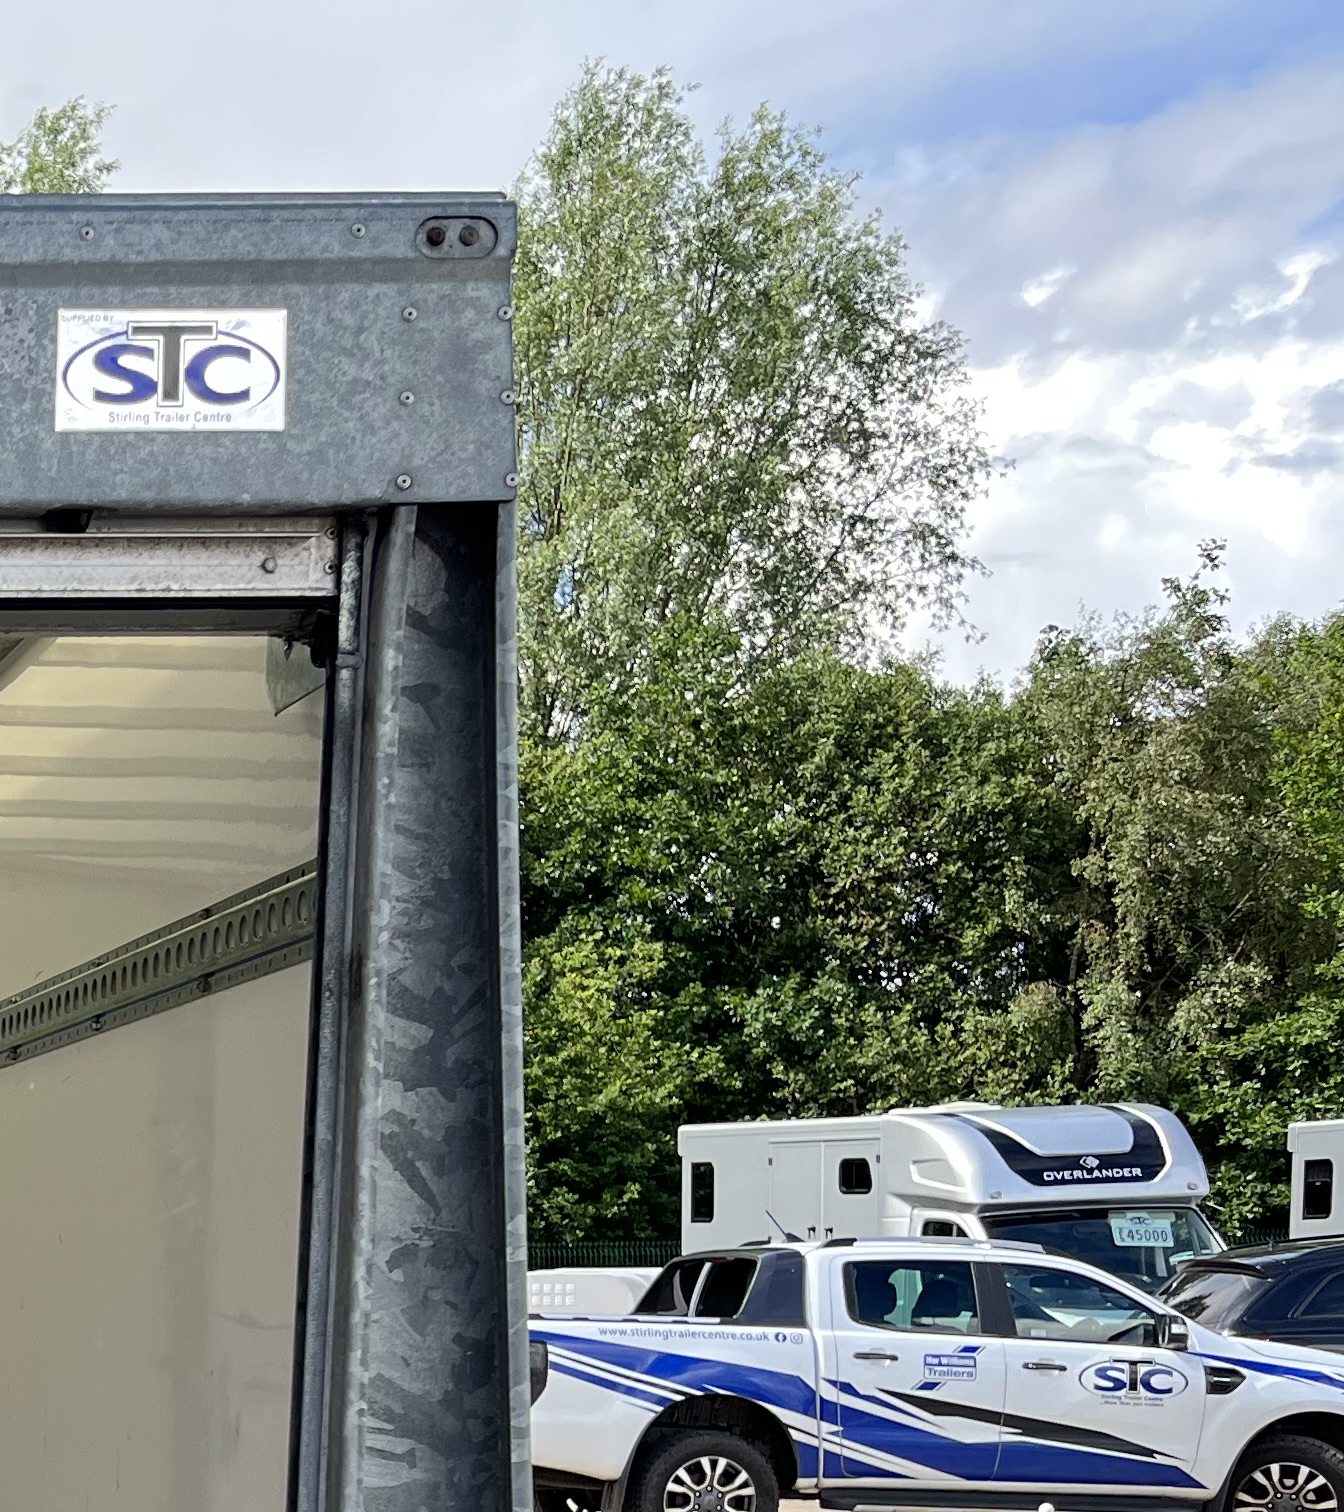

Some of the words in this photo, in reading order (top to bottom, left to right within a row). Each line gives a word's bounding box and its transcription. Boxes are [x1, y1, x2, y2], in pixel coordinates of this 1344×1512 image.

[92, 321, 252, 408] STC
[108, 411, 150, 426] Stirling
[154, 411, 191, 423] Trailer
[193, 411, 233, 423] Centre
[1043, 1167, 1143, 1181] OVERLANDER
[598, 1327, 769, 1342] www.stirlingtrailercentre.co.uk
[927, 1367, 974, 1378] Trailers
[1093, 1358, 1173, 1394] STC
